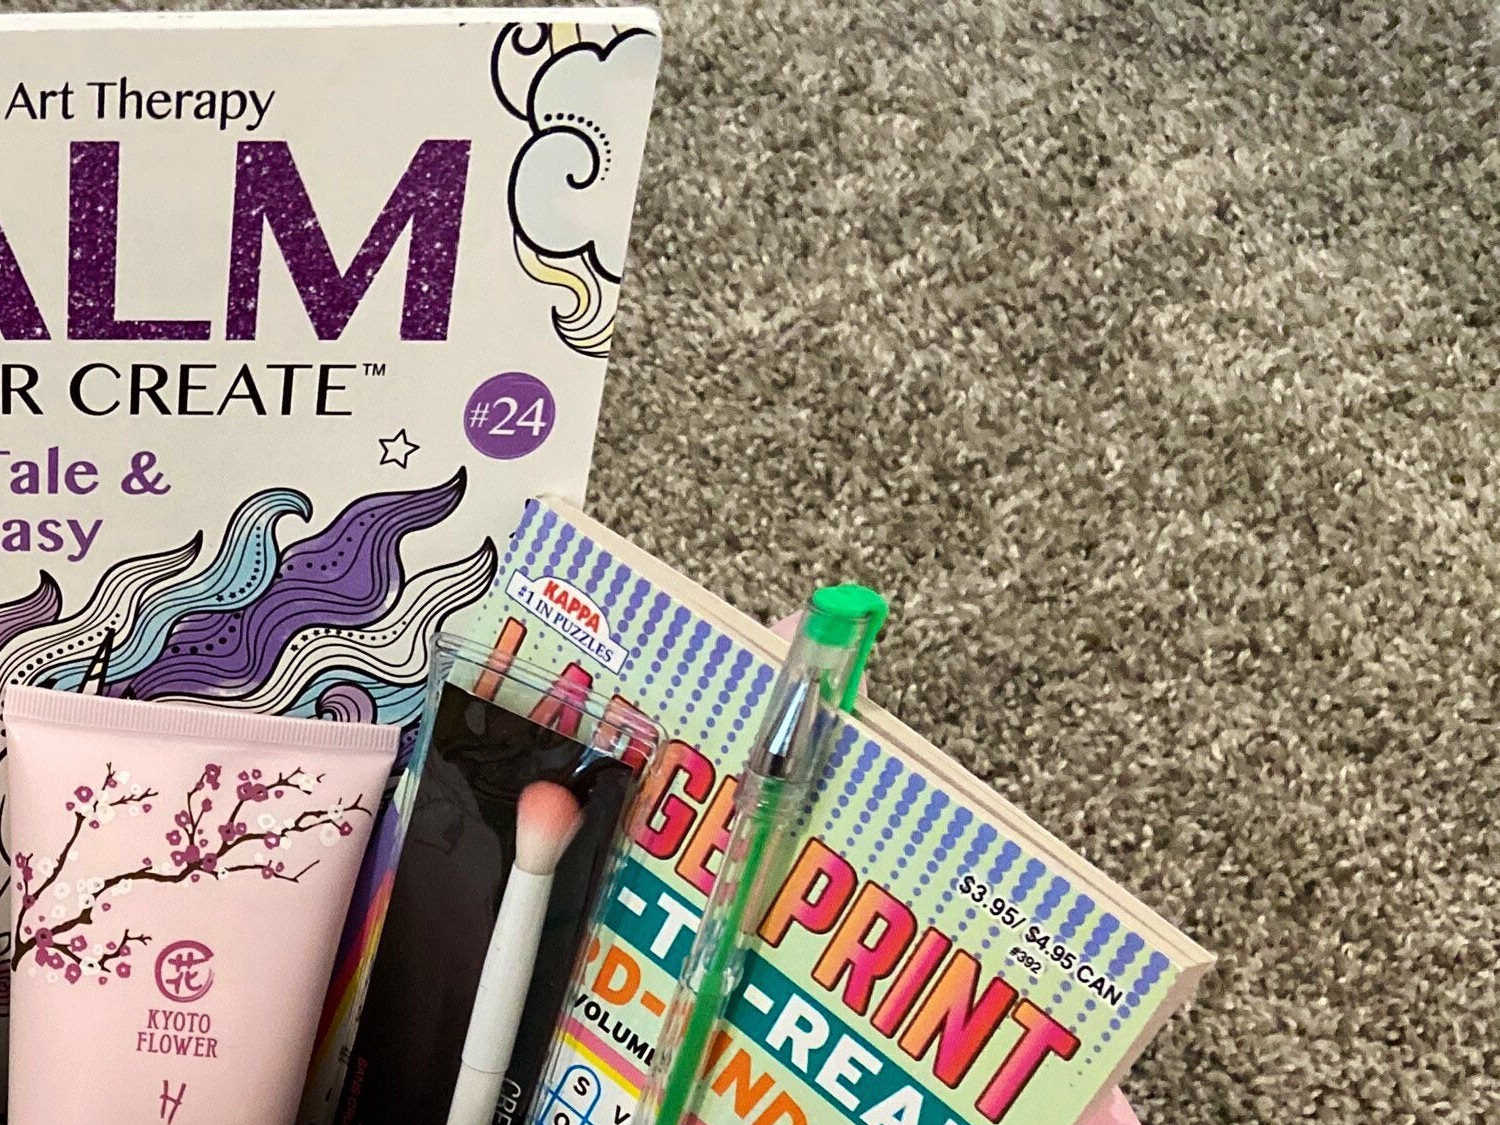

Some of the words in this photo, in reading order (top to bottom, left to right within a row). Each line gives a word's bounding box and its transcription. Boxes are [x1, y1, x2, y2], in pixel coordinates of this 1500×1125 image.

[5, 81, 74, 120] Art
[87, 76, 276, 130] Therapy
[469, 397, 547, 438] #24
[121, 449, 172, 496] &
[518, 586, 534, 605] #1
[535, 600, 553, 619] IN
[553, 613, 613, 663] PUZZLES
[543, 580, 600, 634] KAPPA
[959, 876, 1026, 929] $3.95/
[1025, 926, 1076, 970] $4.95
[1076, 965, 1123, 1006] CAN
[1009, 947, 1042, 974] #392
[757, 836, 1082, 1125] PRINT
[136, 1031, 218, 1059] FLOWER
[147, 1009, 211, 1034] KYOTO
